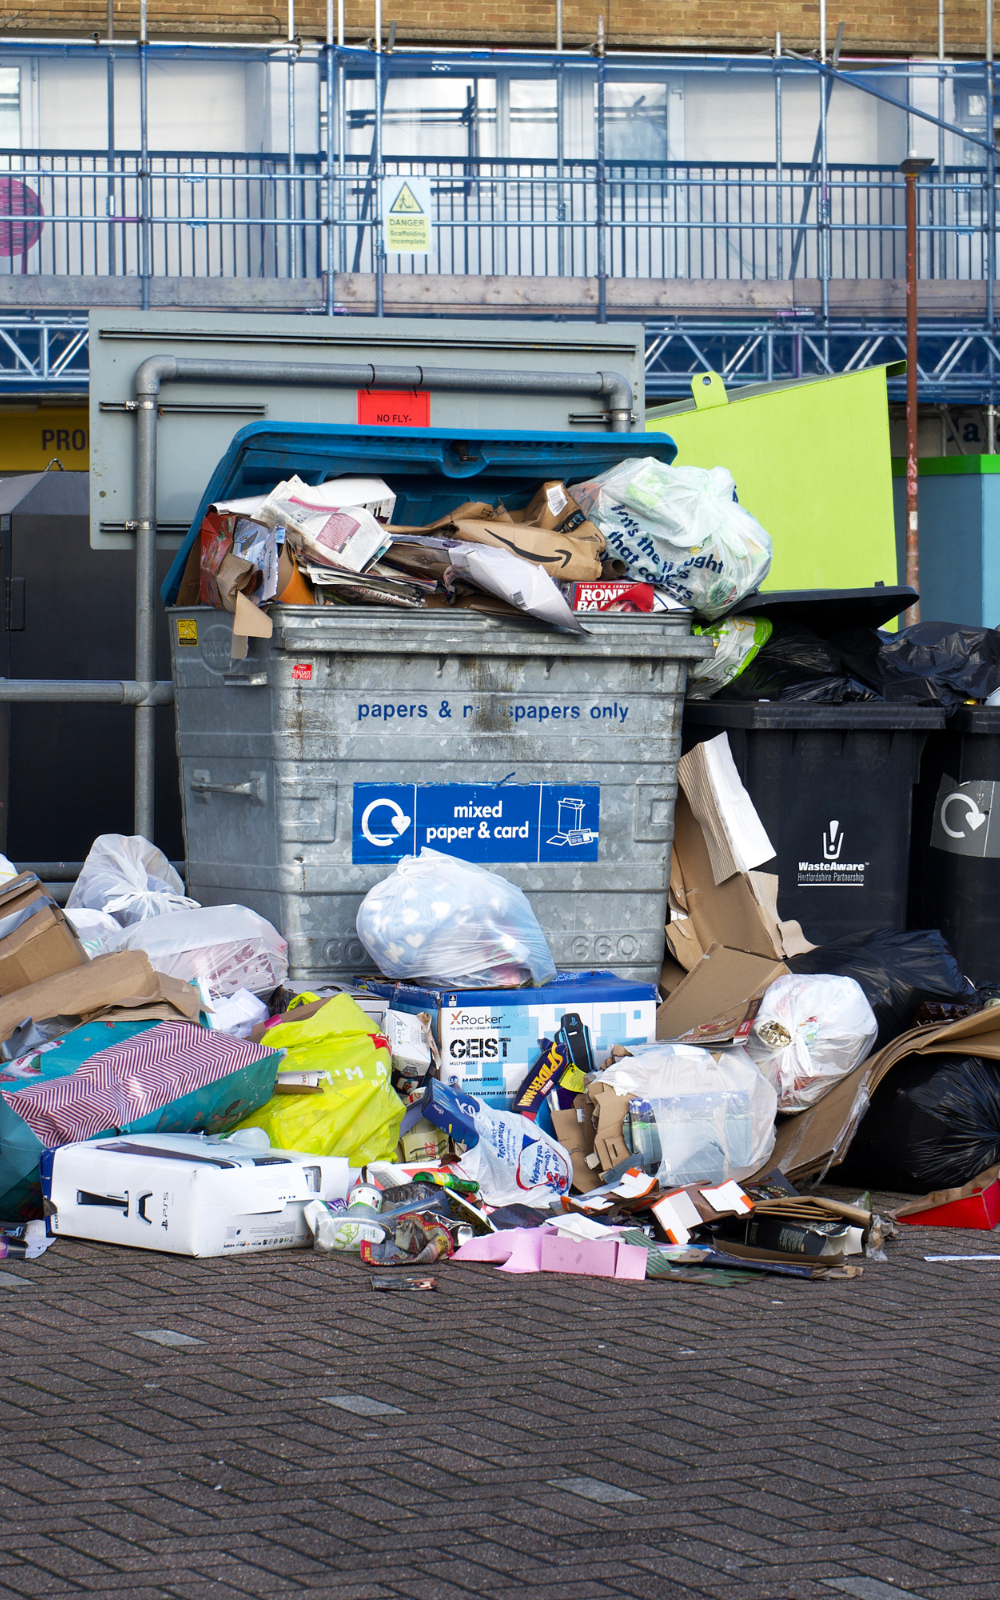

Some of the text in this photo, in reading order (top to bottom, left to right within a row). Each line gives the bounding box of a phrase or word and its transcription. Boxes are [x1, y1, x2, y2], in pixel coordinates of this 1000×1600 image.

[389, 218, 424, 227] DANGER
[390, 230, 426, 238] Scaffolding
[376, 414, 413, 423] NO FLY-
[41, 428, 89, 452] PRO
[608, 530, 640, 565] that
[637, 536, 660, 565] the
[357, 699, 629, 723] papers & nspapers only
[453, 799, 503, 818] mixed
[426, 820, 529, 844] paper & card
[797, 872, 864, 883] Hertfordshire Partnership
[323, 938, 367, 966] CO
[571, 934, 640, 961] 660
[449, 1037, 511, 1059] GEIST
[517, 1041, 564, 1107] SPIDER-MAN
